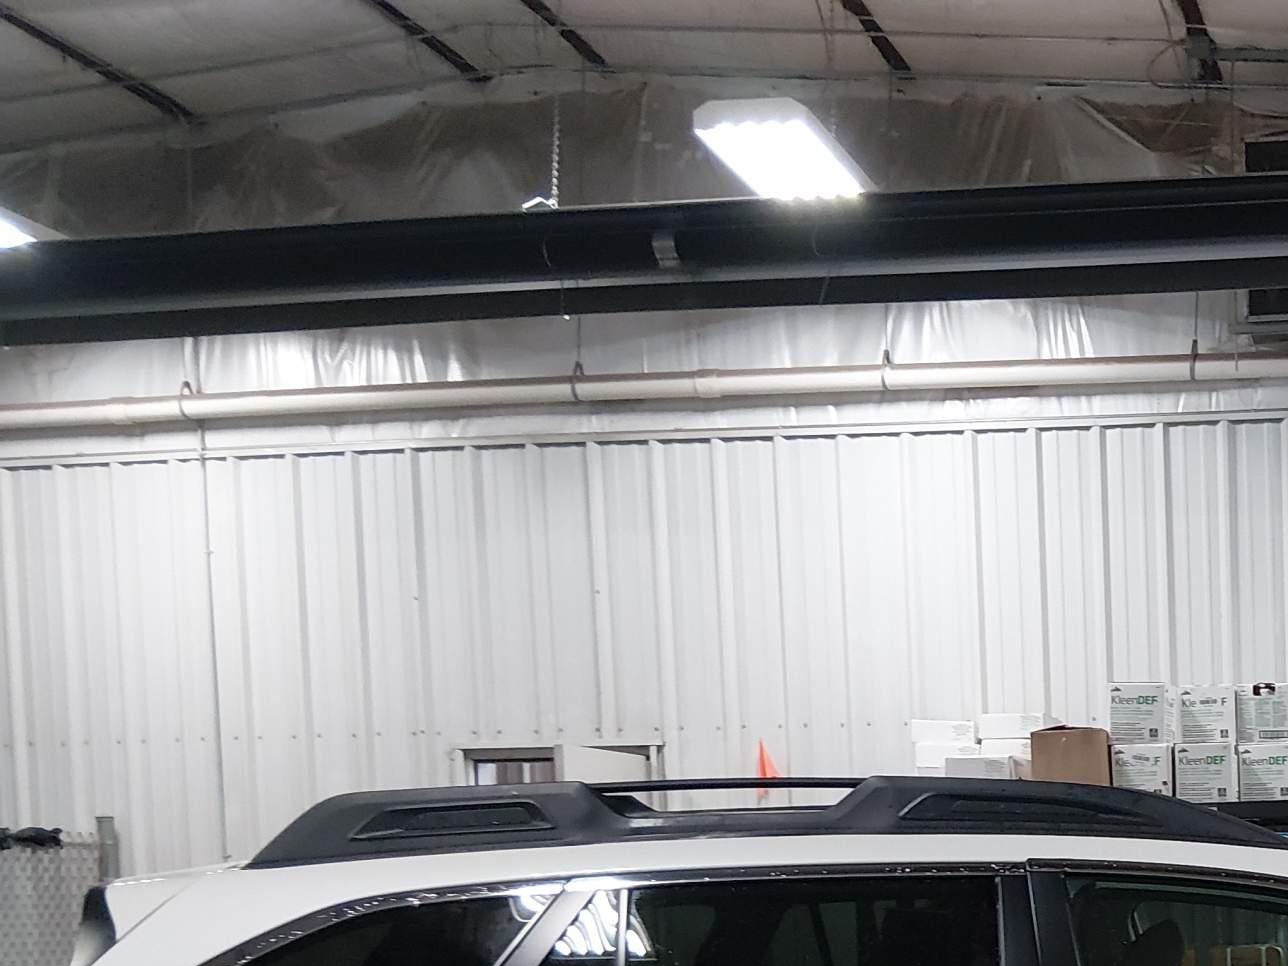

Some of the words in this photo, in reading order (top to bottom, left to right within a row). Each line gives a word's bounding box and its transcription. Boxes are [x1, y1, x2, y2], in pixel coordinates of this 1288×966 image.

[1111, 695, 1158, 705] KleenDEF
[1178, 755, 1226, 767] KleenDEF
[1241, 755, 1288, 767] KleenDEF
